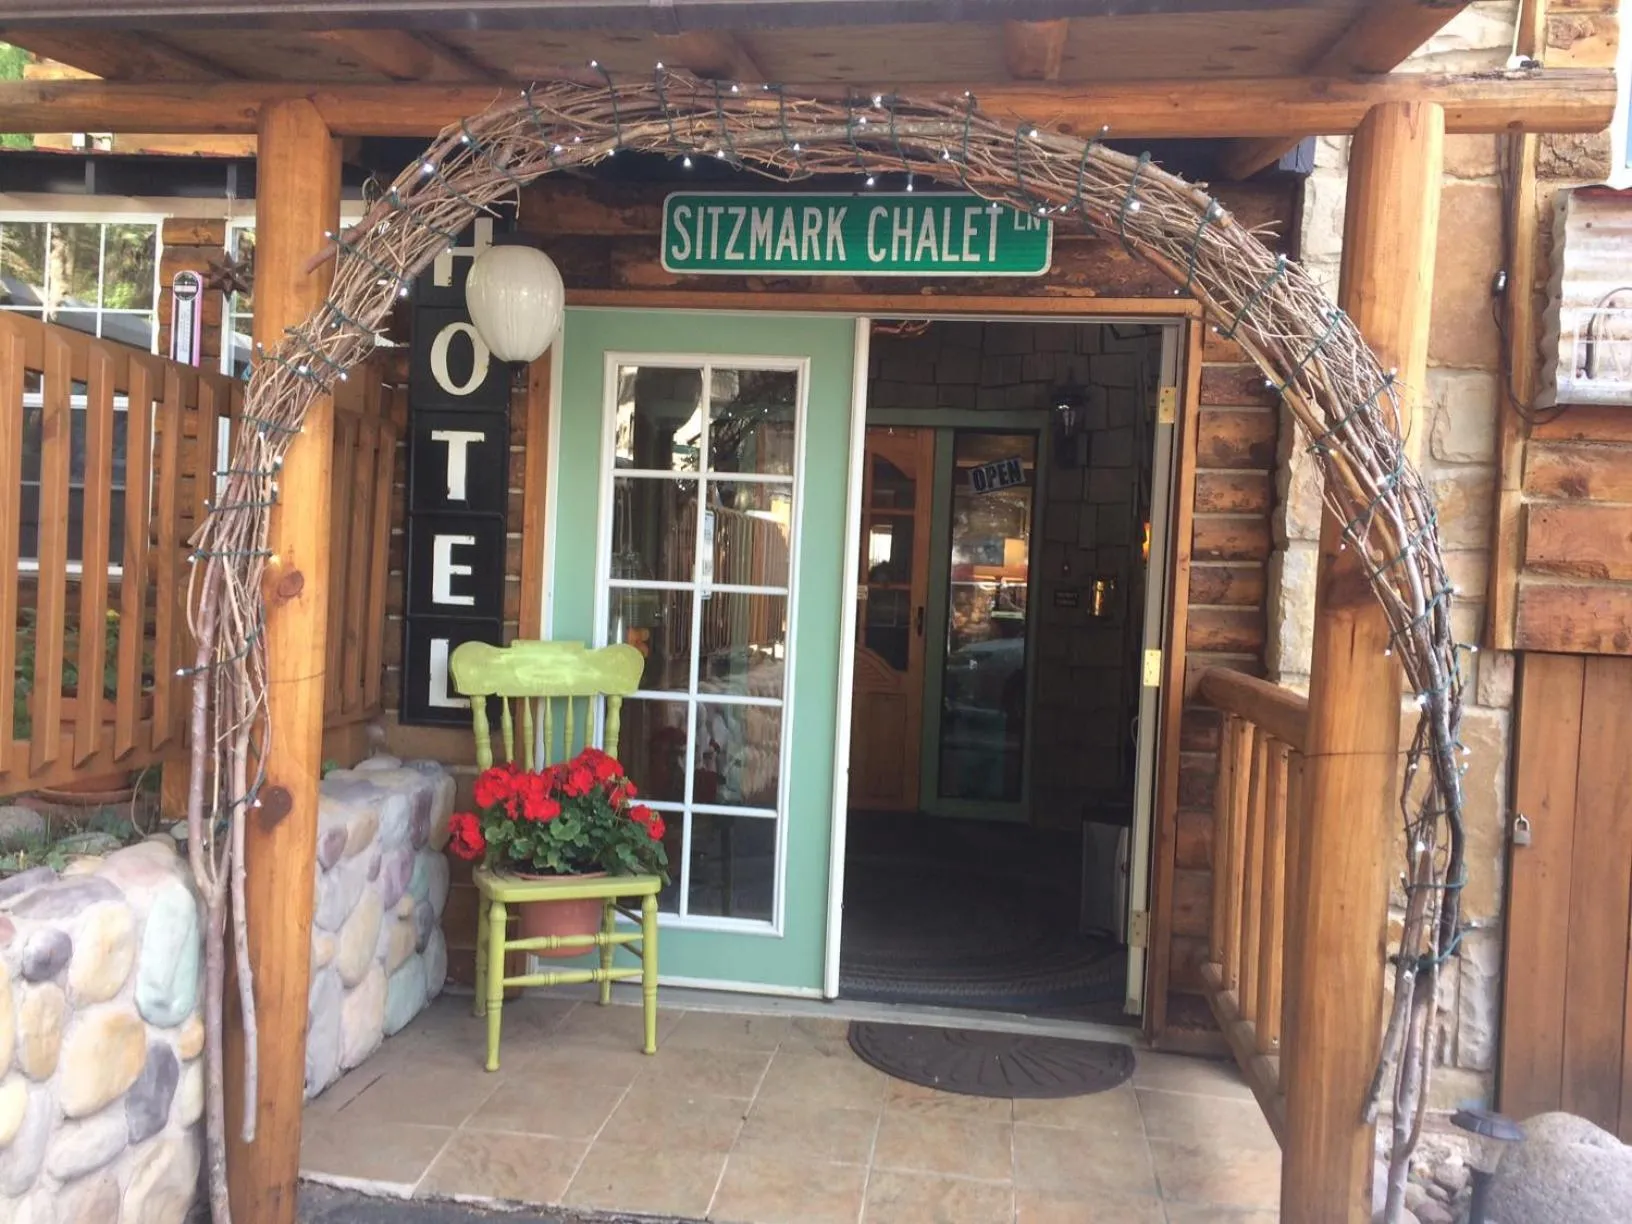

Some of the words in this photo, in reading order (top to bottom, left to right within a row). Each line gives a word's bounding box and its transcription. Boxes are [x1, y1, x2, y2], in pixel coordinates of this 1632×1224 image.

[671, 205, 847, 262] SITZMARK
[867, 205, 1004, 263] CHALET
[972, 459, 1022, 491] OPEN
